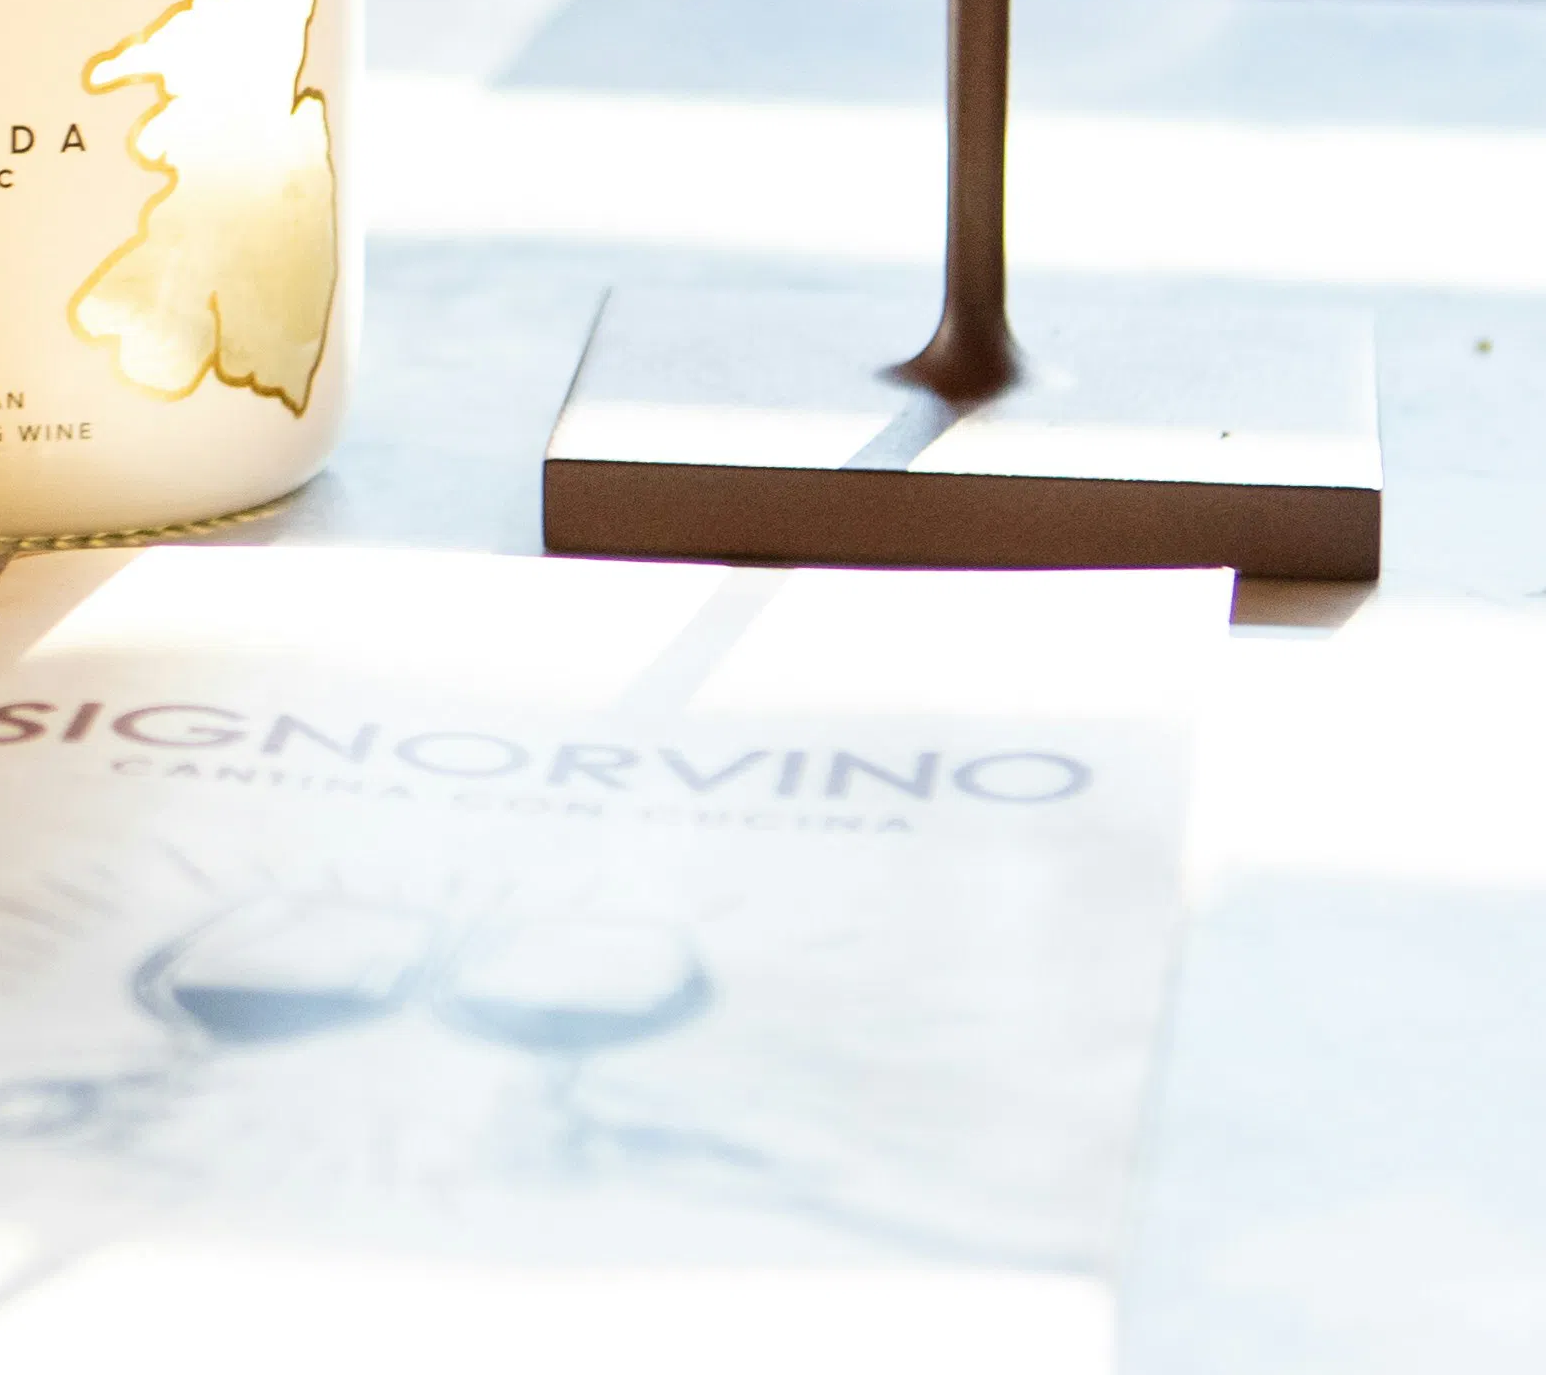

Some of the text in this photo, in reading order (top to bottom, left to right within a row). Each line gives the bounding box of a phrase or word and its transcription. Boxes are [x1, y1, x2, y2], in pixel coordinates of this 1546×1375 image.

[19, 421, 93, 441] WINE
[107, 755, 916, 836] CANTINA CON CUCINA
